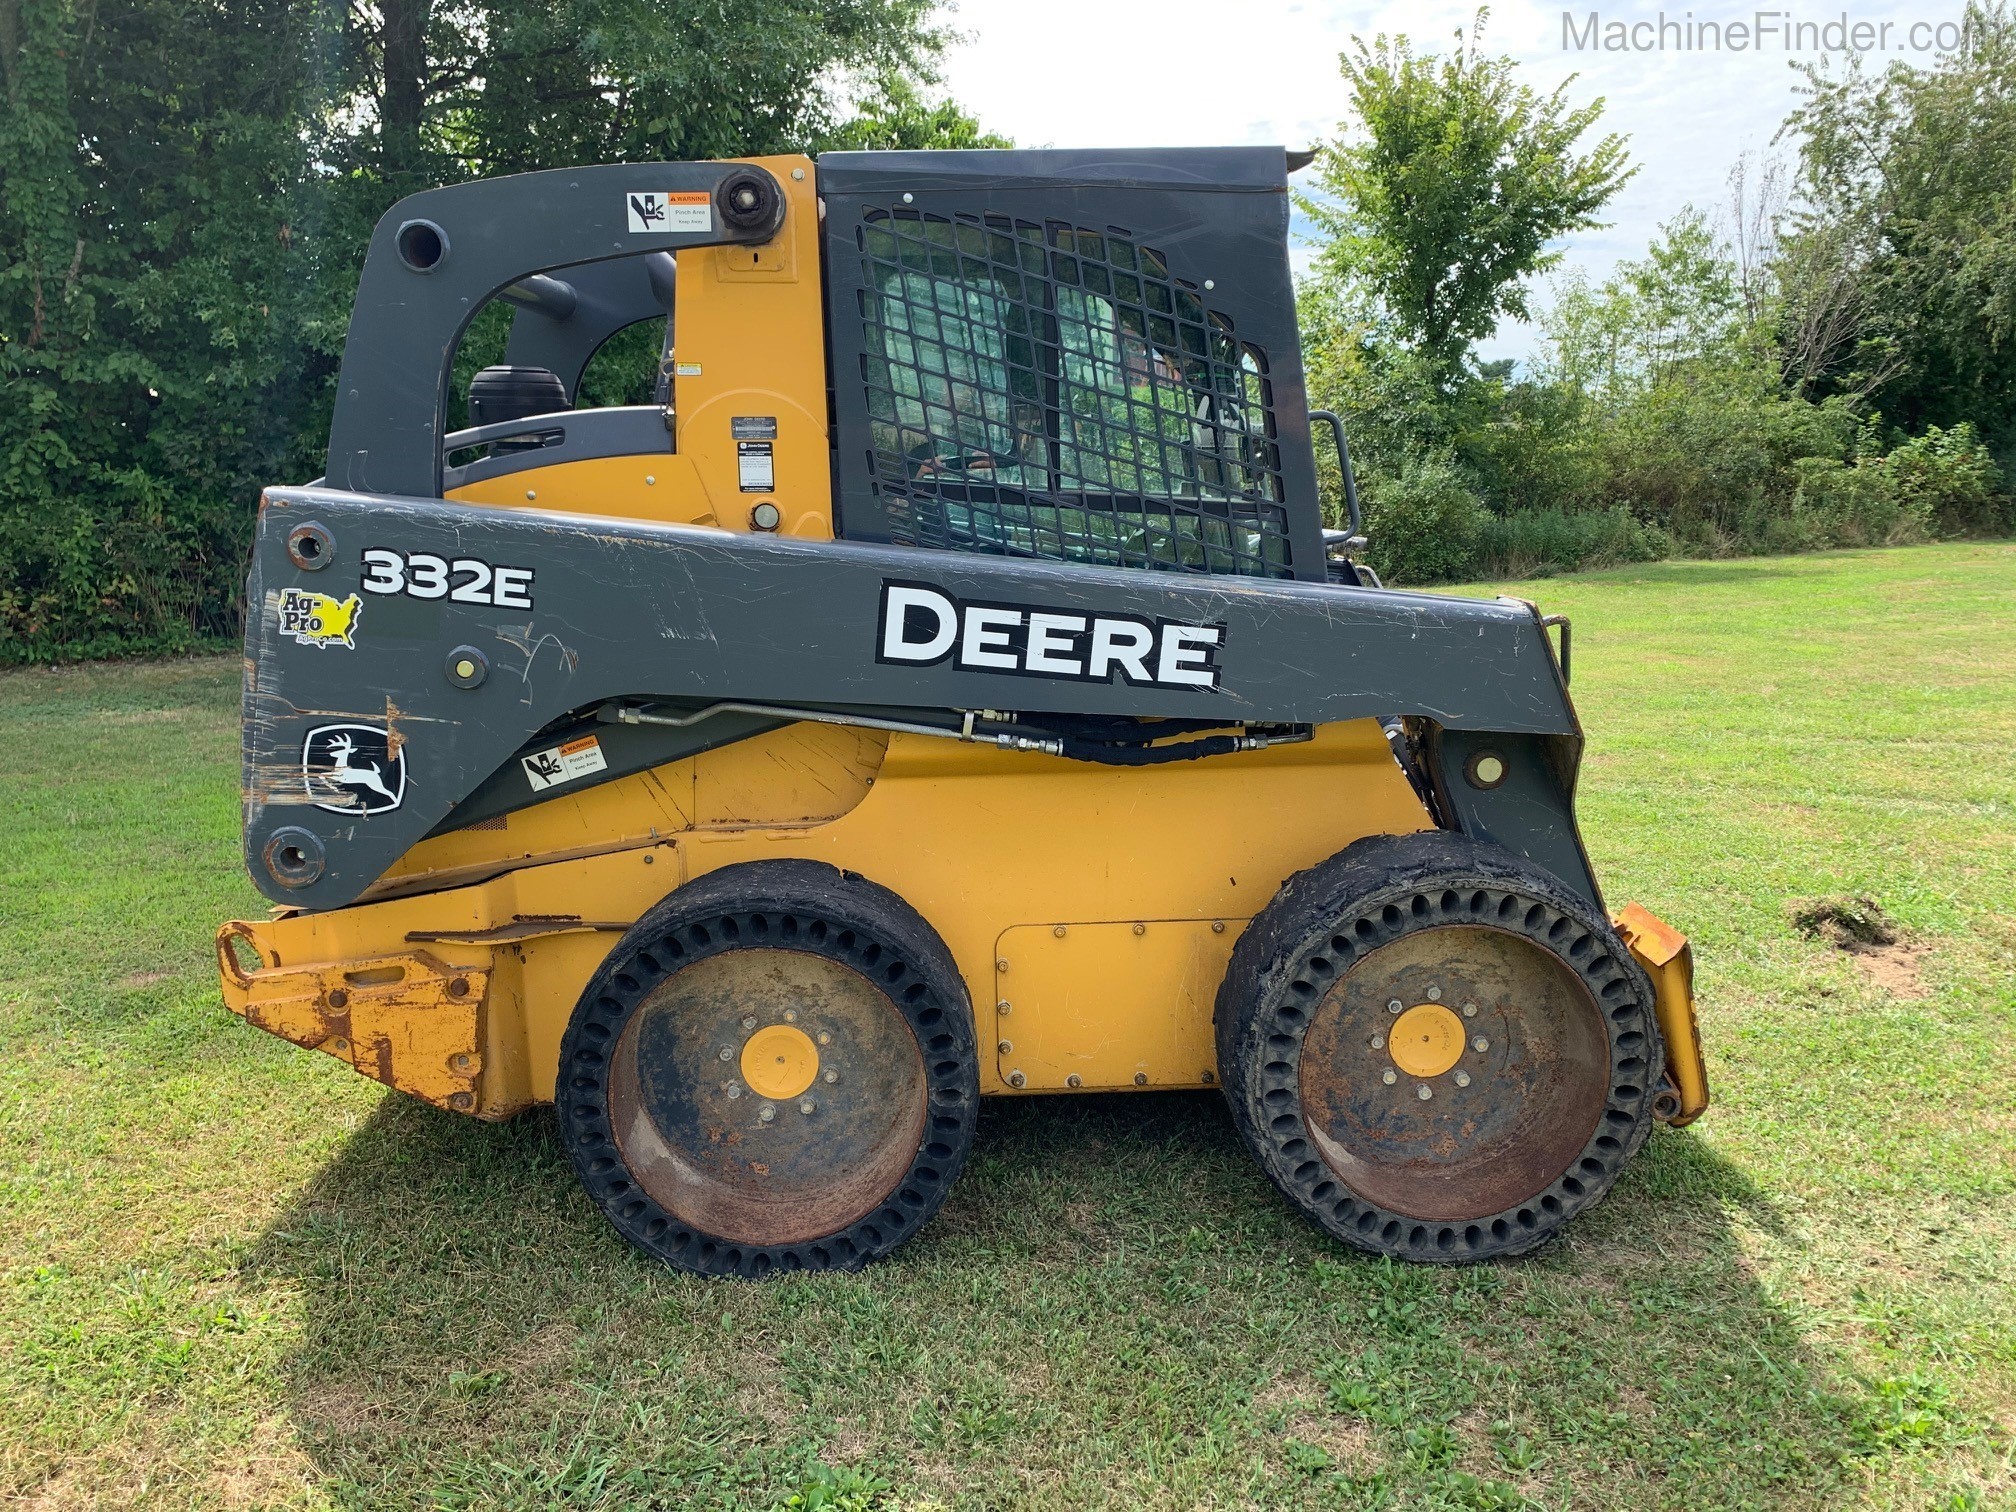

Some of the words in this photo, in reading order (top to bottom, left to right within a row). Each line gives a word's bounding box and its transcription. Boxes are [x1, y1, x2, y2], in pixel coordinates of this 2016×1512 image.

[362, 549, 533, 609] 332E
[282, 592, 321, 616] Ag-
[283, 612, 322, 631] Pro
[883, 586, 1219, 686] DEERE
[567, 740, 594, 752] WARNING
[569, 755, 585, 764] Pinch
[585, 751, 597, 759] Area
